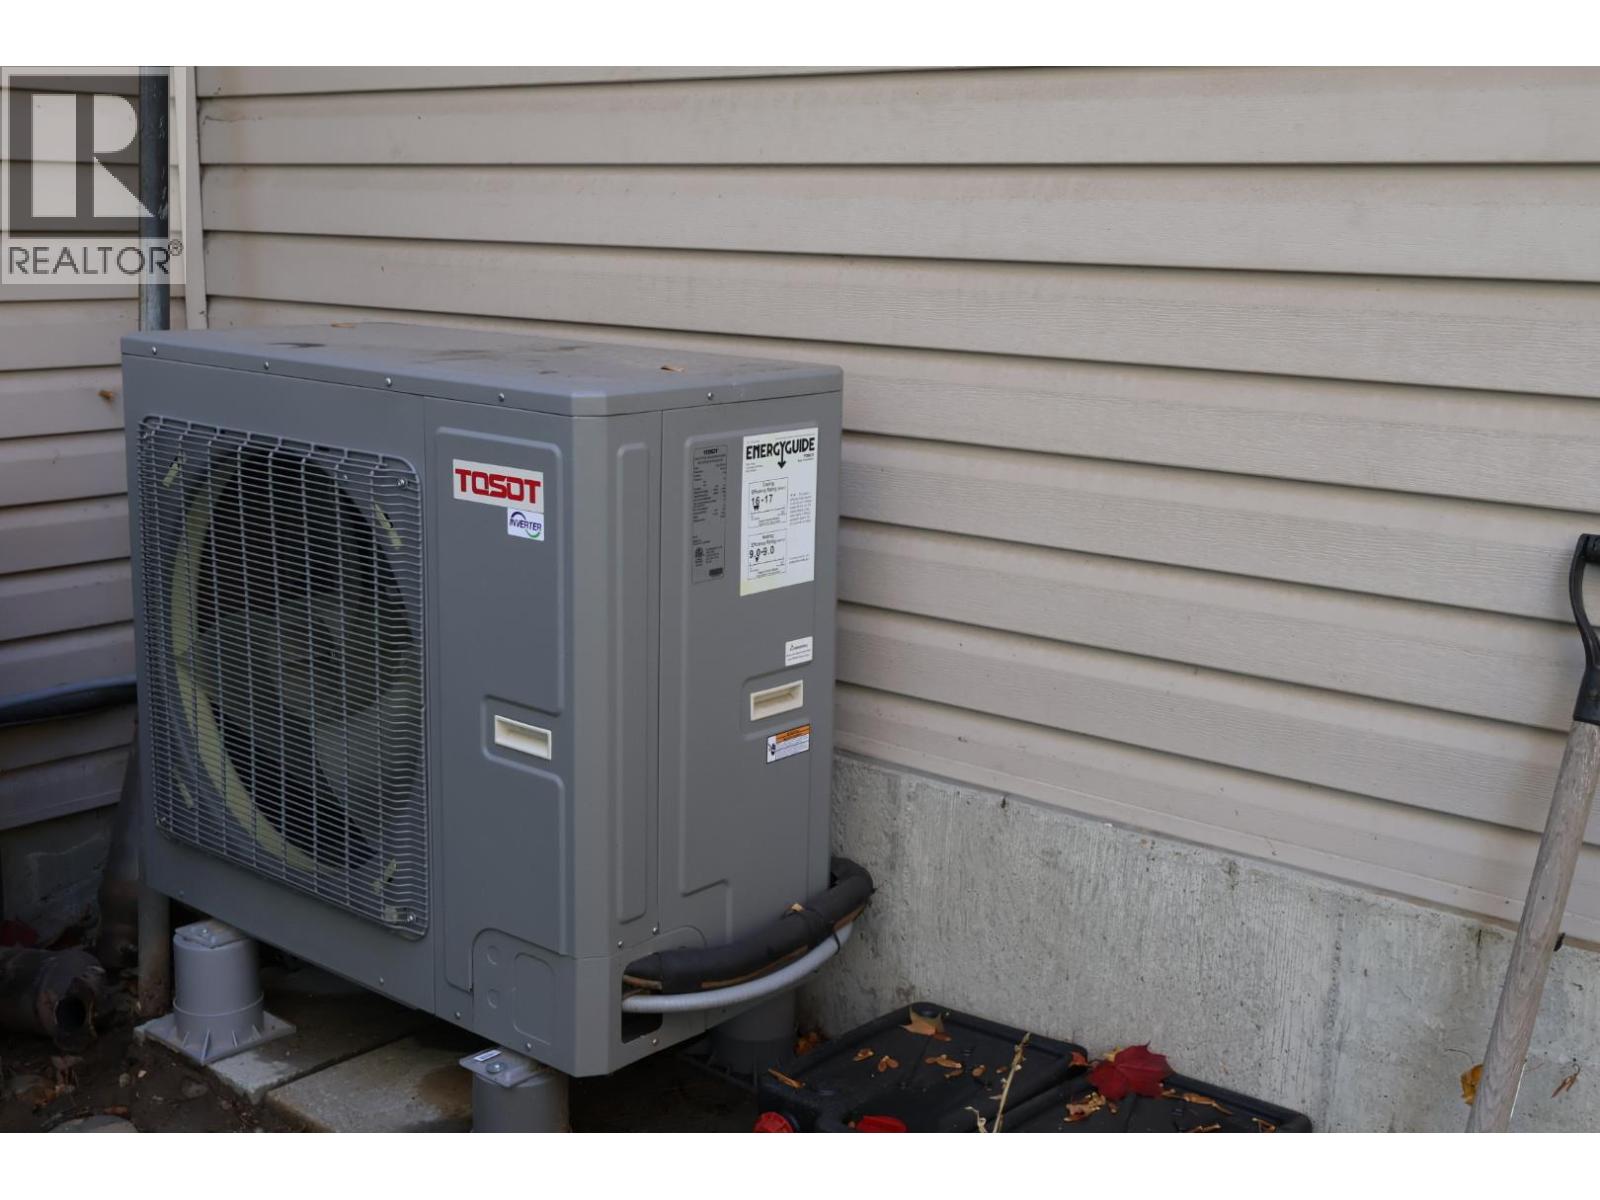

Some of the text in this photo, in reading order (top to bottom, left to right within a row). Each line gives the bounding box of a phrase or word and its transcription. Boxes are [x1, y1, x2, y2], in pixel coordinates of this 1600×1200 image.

[746, 437, 815, 461] ENERGYGUIDE
[455, 468, 541, 504] TOSOT
[509, 518, 542, 532] INVERTER
